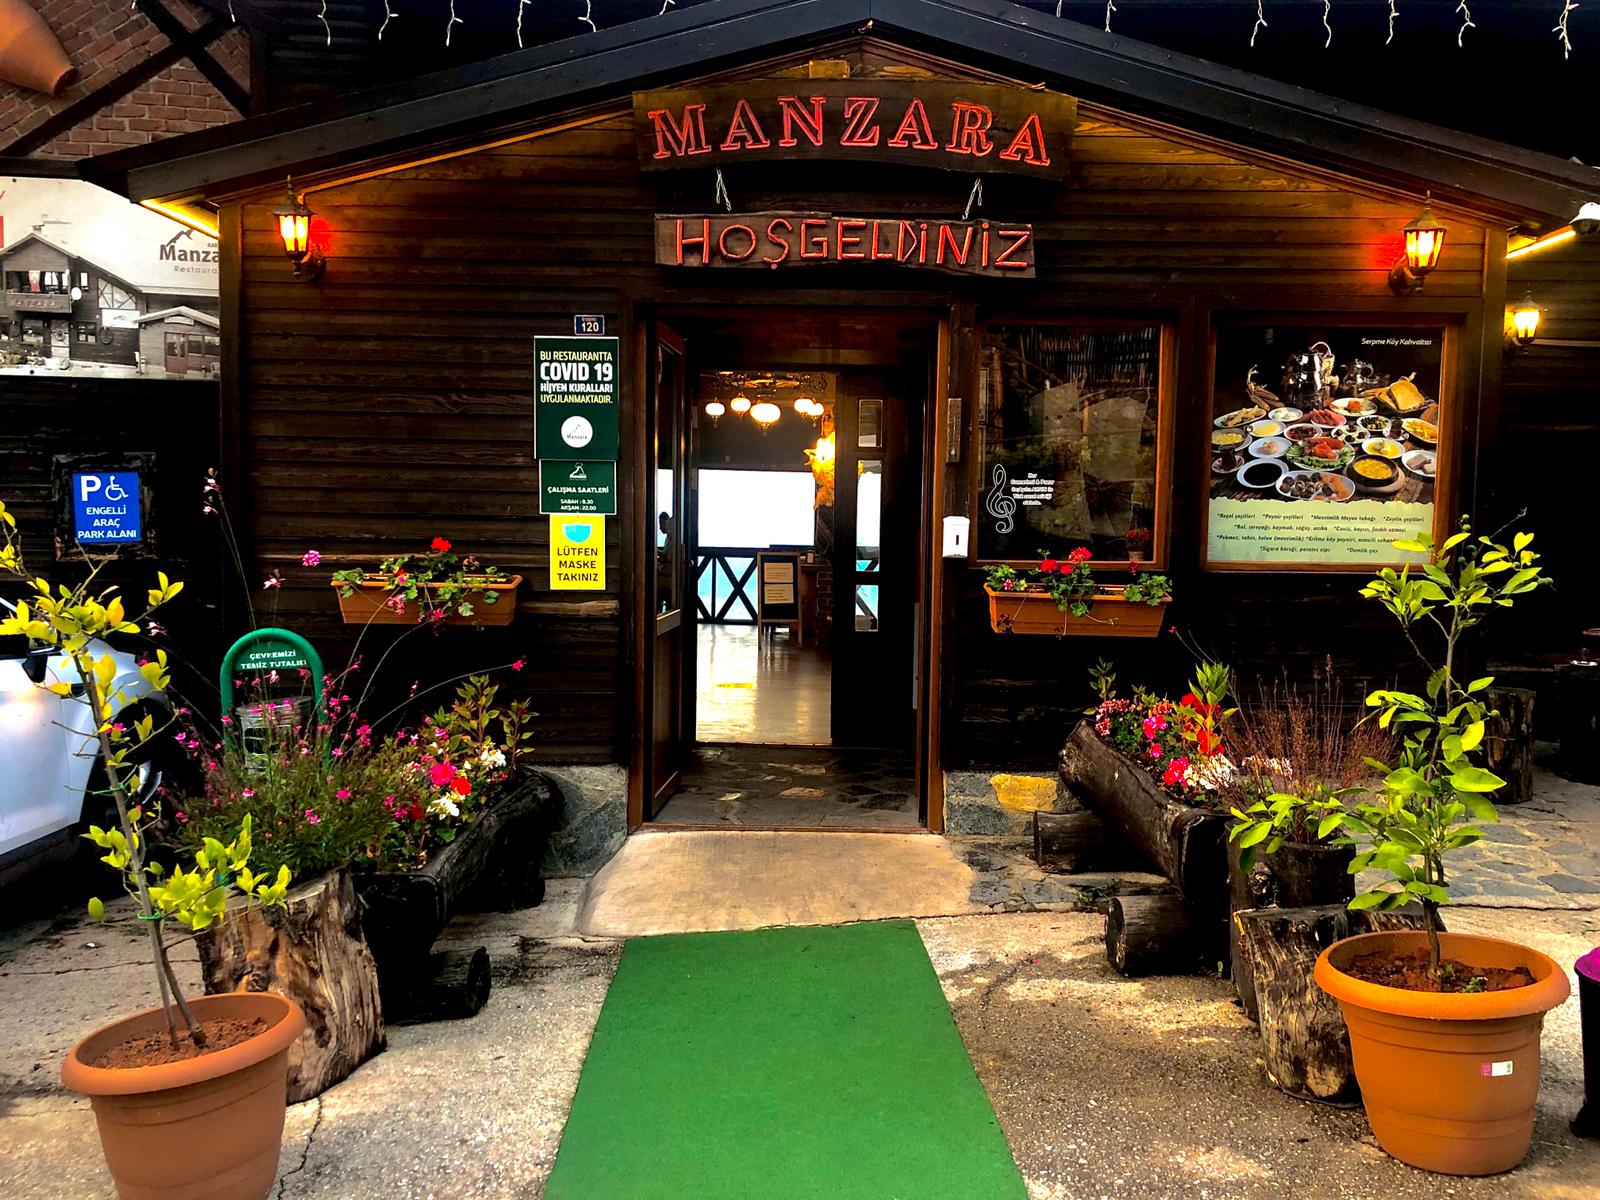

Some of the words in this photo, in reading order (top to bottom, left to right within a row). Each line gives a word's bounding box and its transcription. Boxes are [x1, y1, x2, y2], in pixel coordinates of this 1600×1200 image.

[647, 95, 1051, 166] MANZARA
[581, 321, 600, 332] 120
[1361, 338, 1386, 346] Serpme
[1386, 338, 1399, 346] Köy
[540, 351, 551, 360] BU
[553, 351, 613, 361] RESTAURANTTA
[540, 362, 590, 381] COVID
[594, 362, 613, 382] 19
[540, 381, 568, 394] HİJYEN
[569, 383, 613, 392] KURALLARI
[540, 394, 613, 404] UYGULANMAKTADIR.
[80, 475, 102, 502] P
[547, 486, 577, 494] ÇALIŞMA
[578, 486, 609, 494] SAATLERİ
[86, 504, 126, 515] ENGELLİ
[93, 518, 120, 528] ARAÇ
[78, 530, 105, 538] PARK
[106, 530, 136, 538] ALANI
[557, 546, 598, 556] LÜTFEN
[558, 560, 596, 569] MASKE
[557, 573, 598, 582] TAKINIZ
[240, 662, 267, 670] TEMİZ
